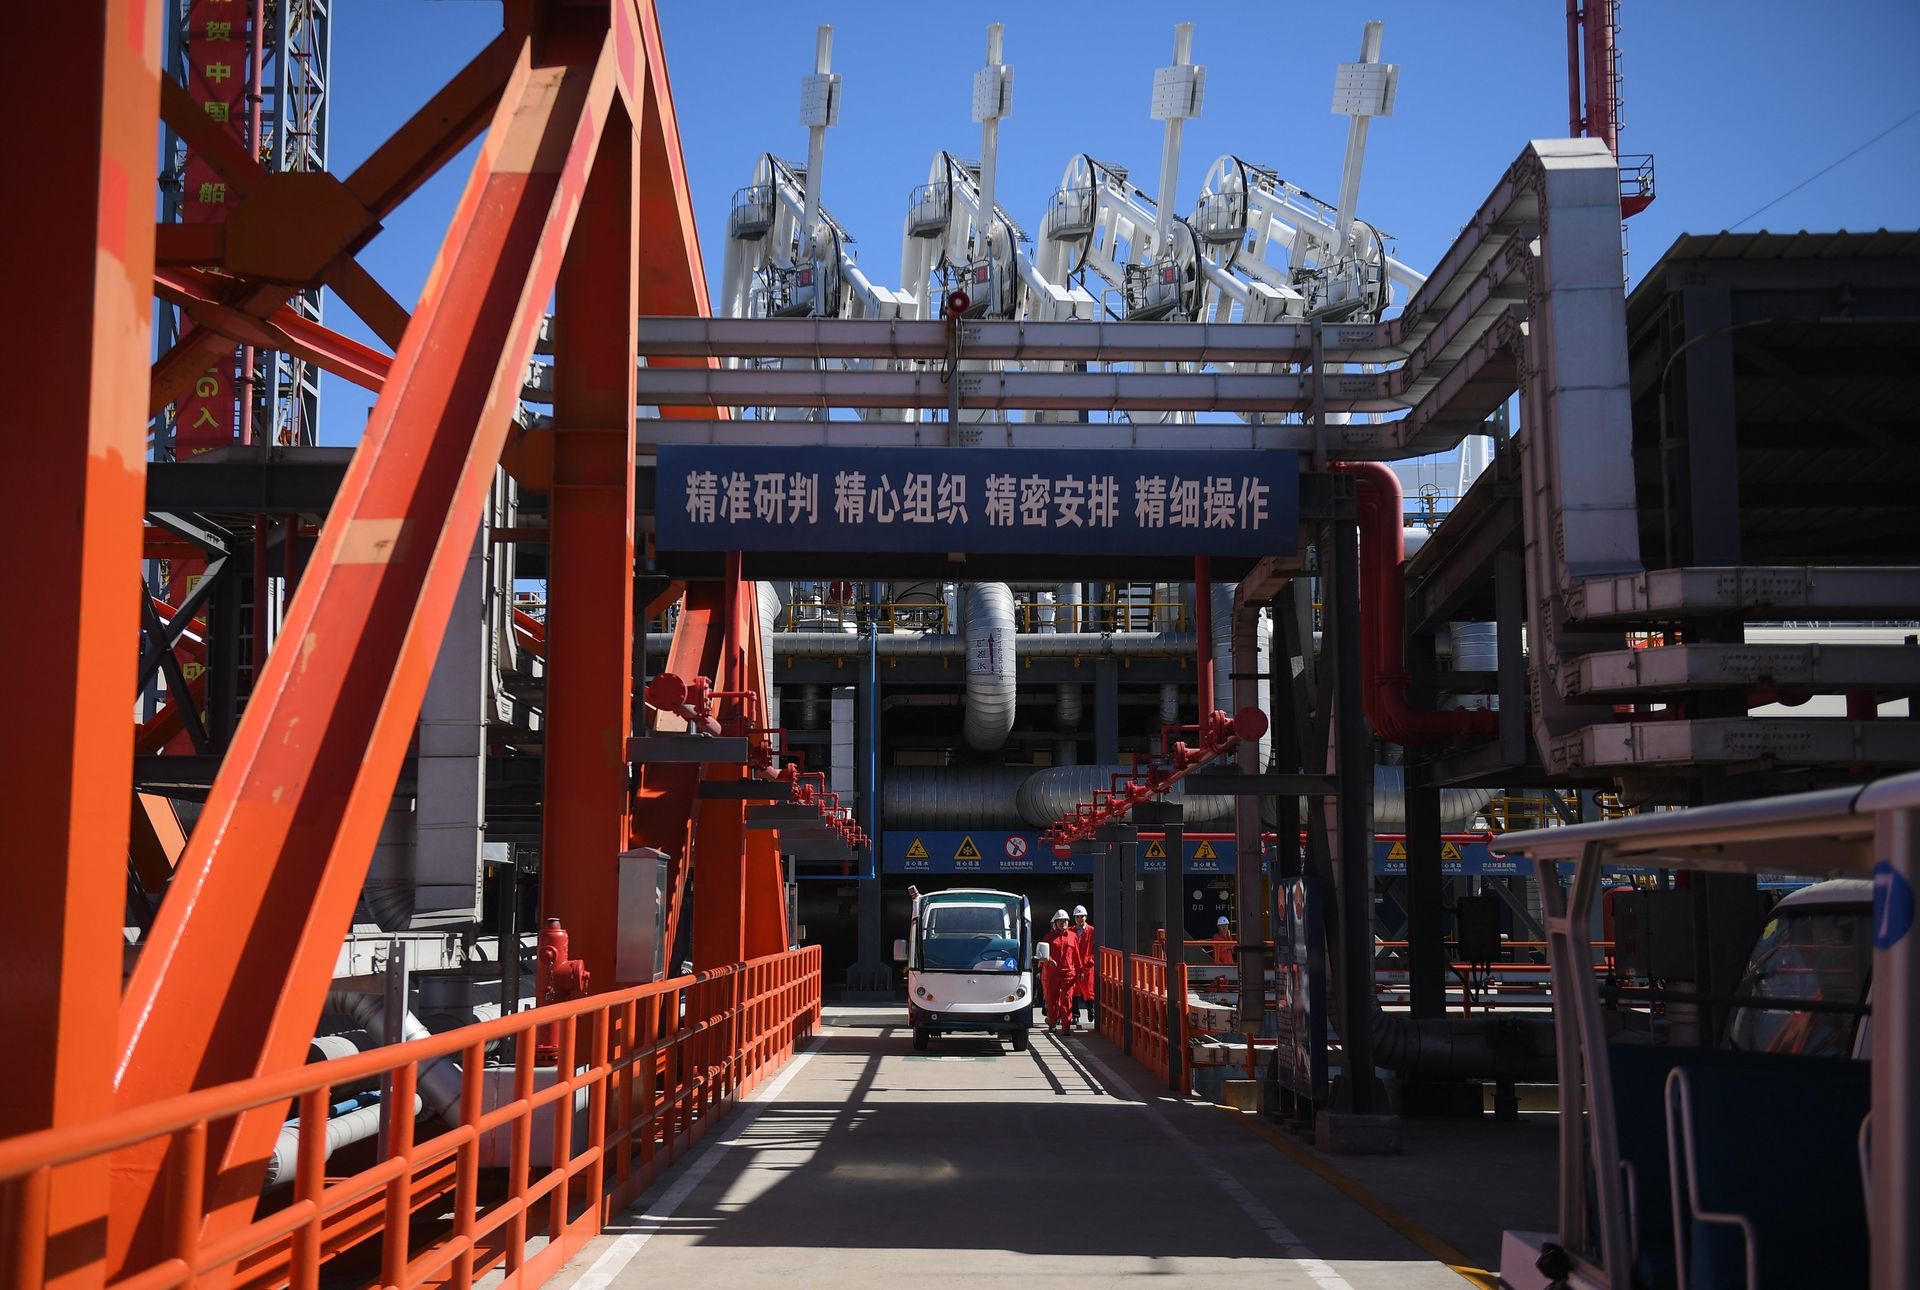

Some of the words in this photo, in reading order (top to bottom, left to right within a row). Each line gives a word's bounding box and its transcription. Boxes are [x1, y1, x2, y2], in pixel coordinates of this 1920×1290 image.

[685, 470, 819, 524] 精准研判
[834, 470, 969, 525] 精心组织
[984, 473, 1120, 528] 精密安排
[1134, 475, 1270, 530] 精细操作
[1007, 959, 1015, 969] 4
